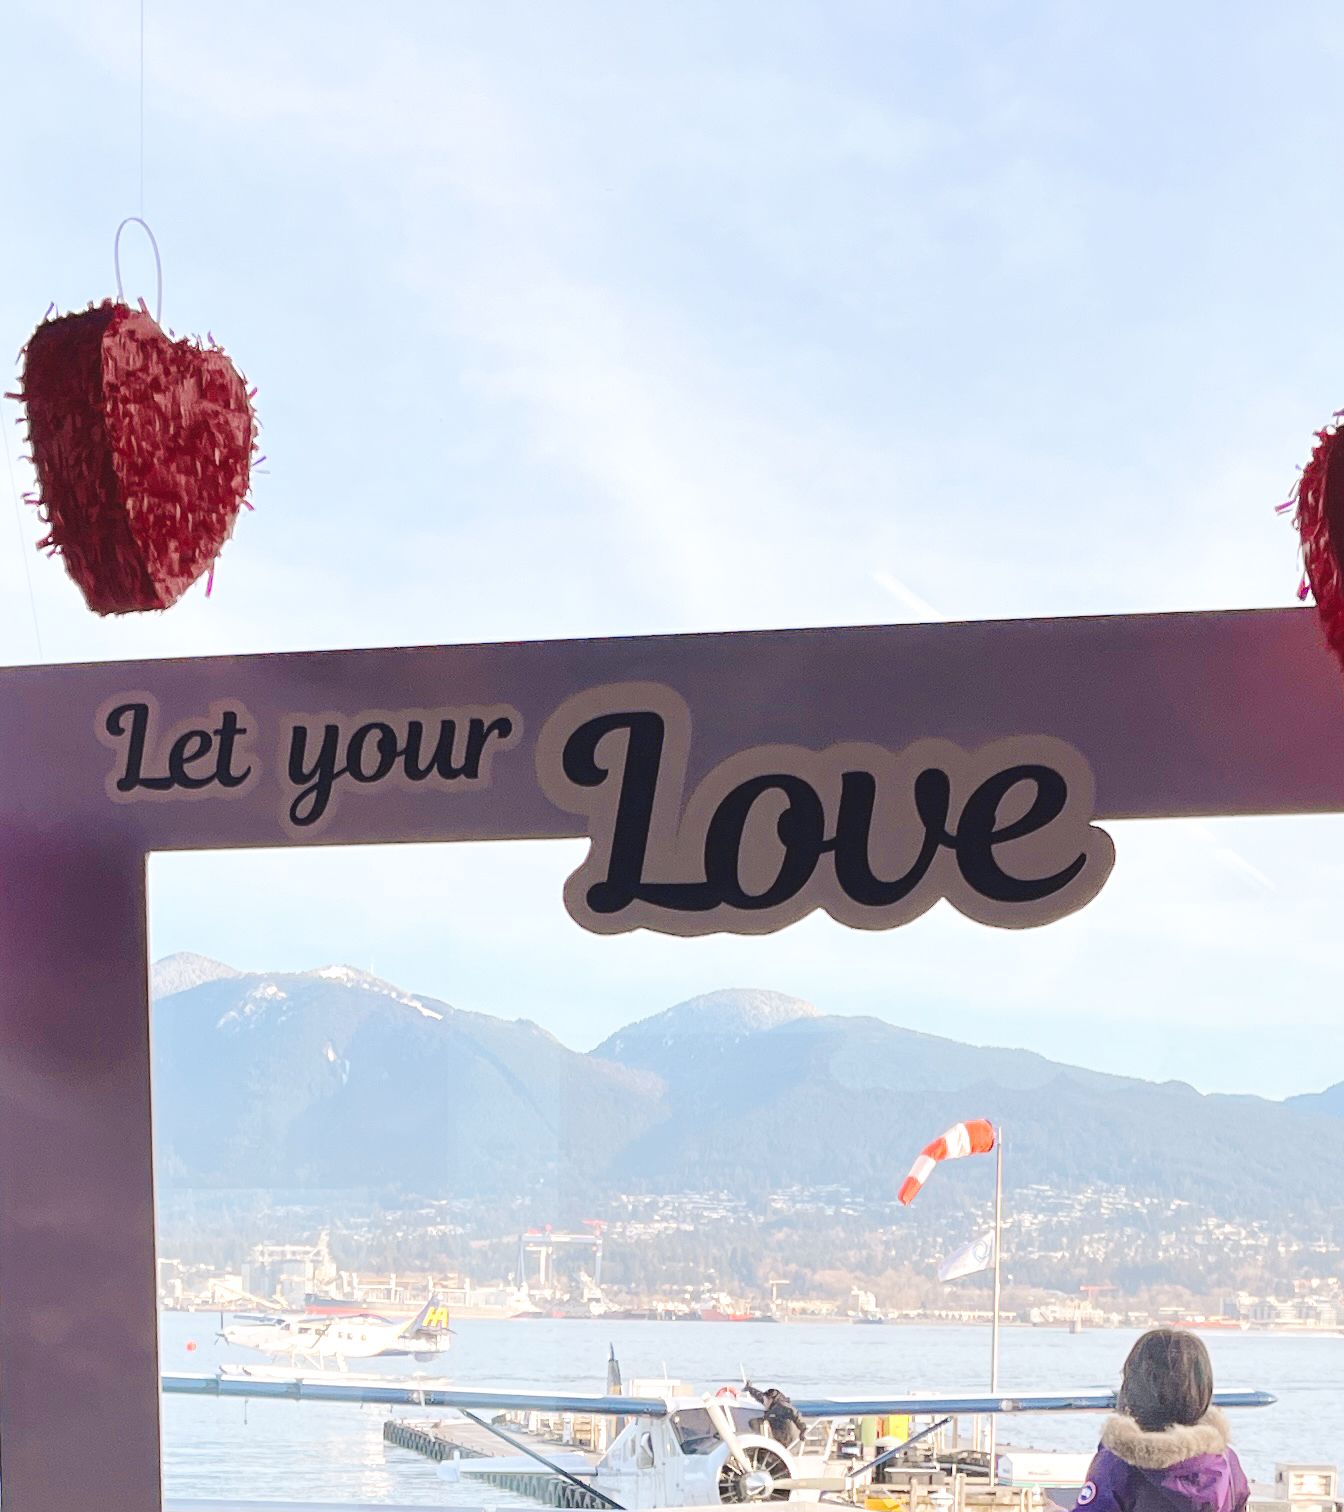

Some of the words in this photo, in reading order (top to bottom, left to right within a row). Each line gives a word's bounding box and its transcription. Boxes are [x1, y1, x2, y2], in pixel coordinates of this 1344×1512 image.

[105, 703, 250, 792] Let
[288, 716, 512, 827] your
[561, 710, 1088, 914] Love
